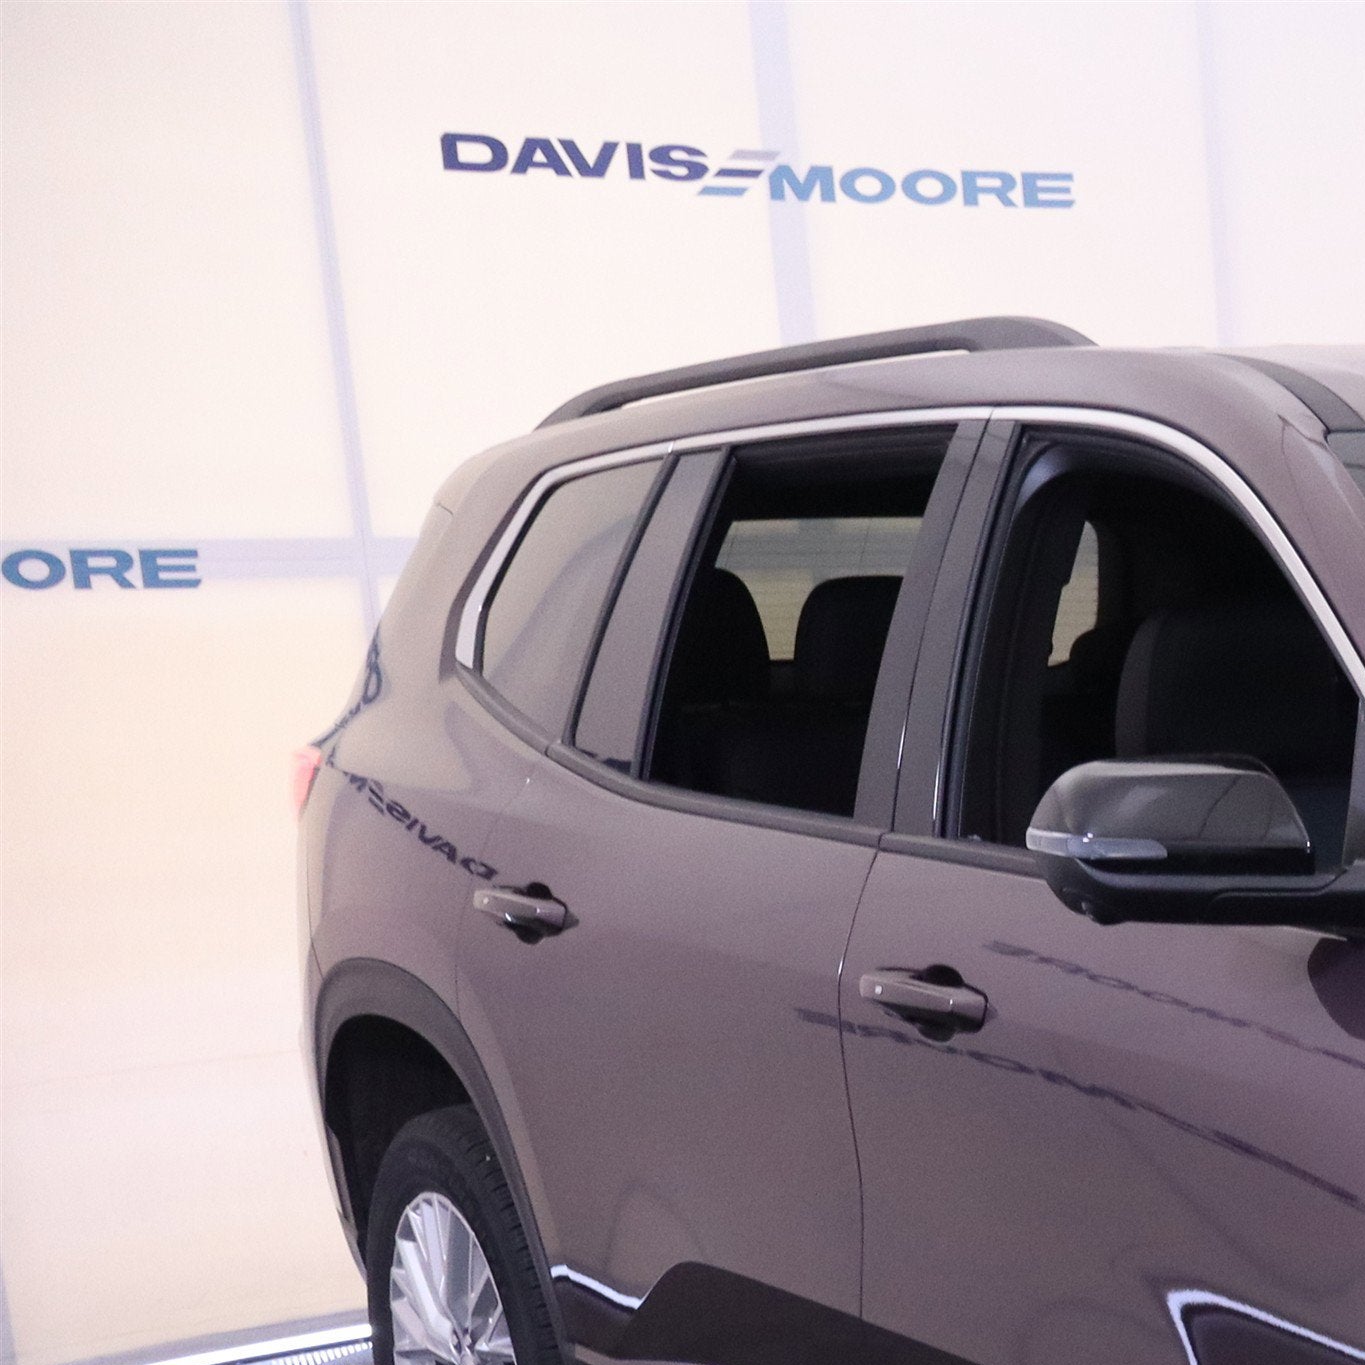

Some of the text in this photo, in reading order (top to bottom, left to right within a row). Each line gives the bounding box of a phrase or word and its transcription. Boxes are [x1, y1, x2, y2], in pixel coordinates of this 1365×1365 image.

[440, 131, 1077, 208] DAVIS MOORE
[0, 548, 202, 590] ORE
